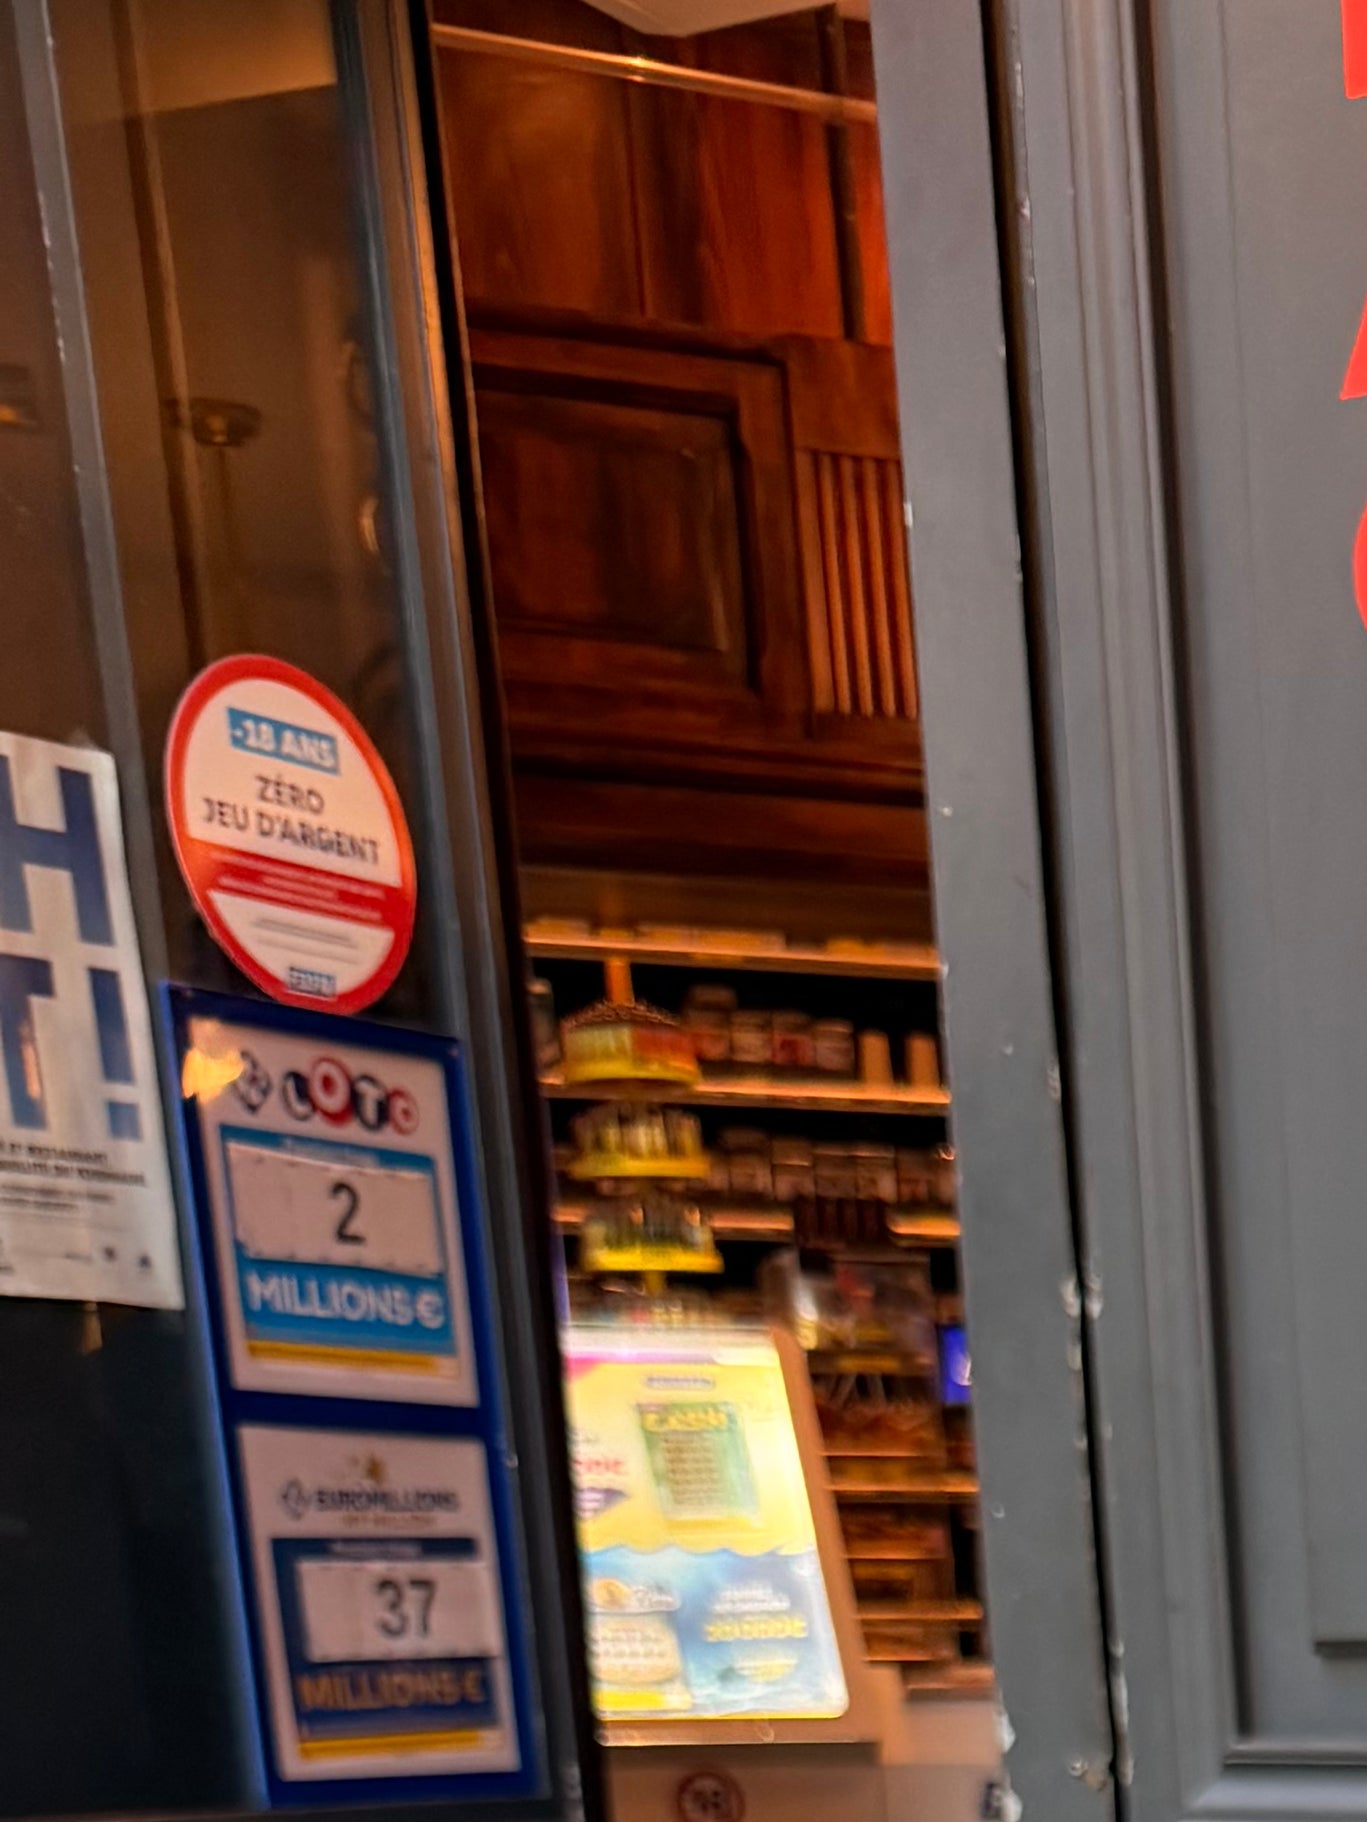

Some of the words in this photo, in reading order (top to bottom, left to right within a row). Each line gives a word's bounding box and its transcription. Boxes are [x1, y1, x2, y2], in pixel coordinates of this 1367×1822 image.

[280, 730, 335, 764] ANS
[255, 773, 325, 814] ZÉRO
[203, 797, 249, 832] JEU
[257, 810, 379, 865] D'ARGENT
[330, 1181, 367, 1245] 2
[375, 1577, 438, 1640] 37
